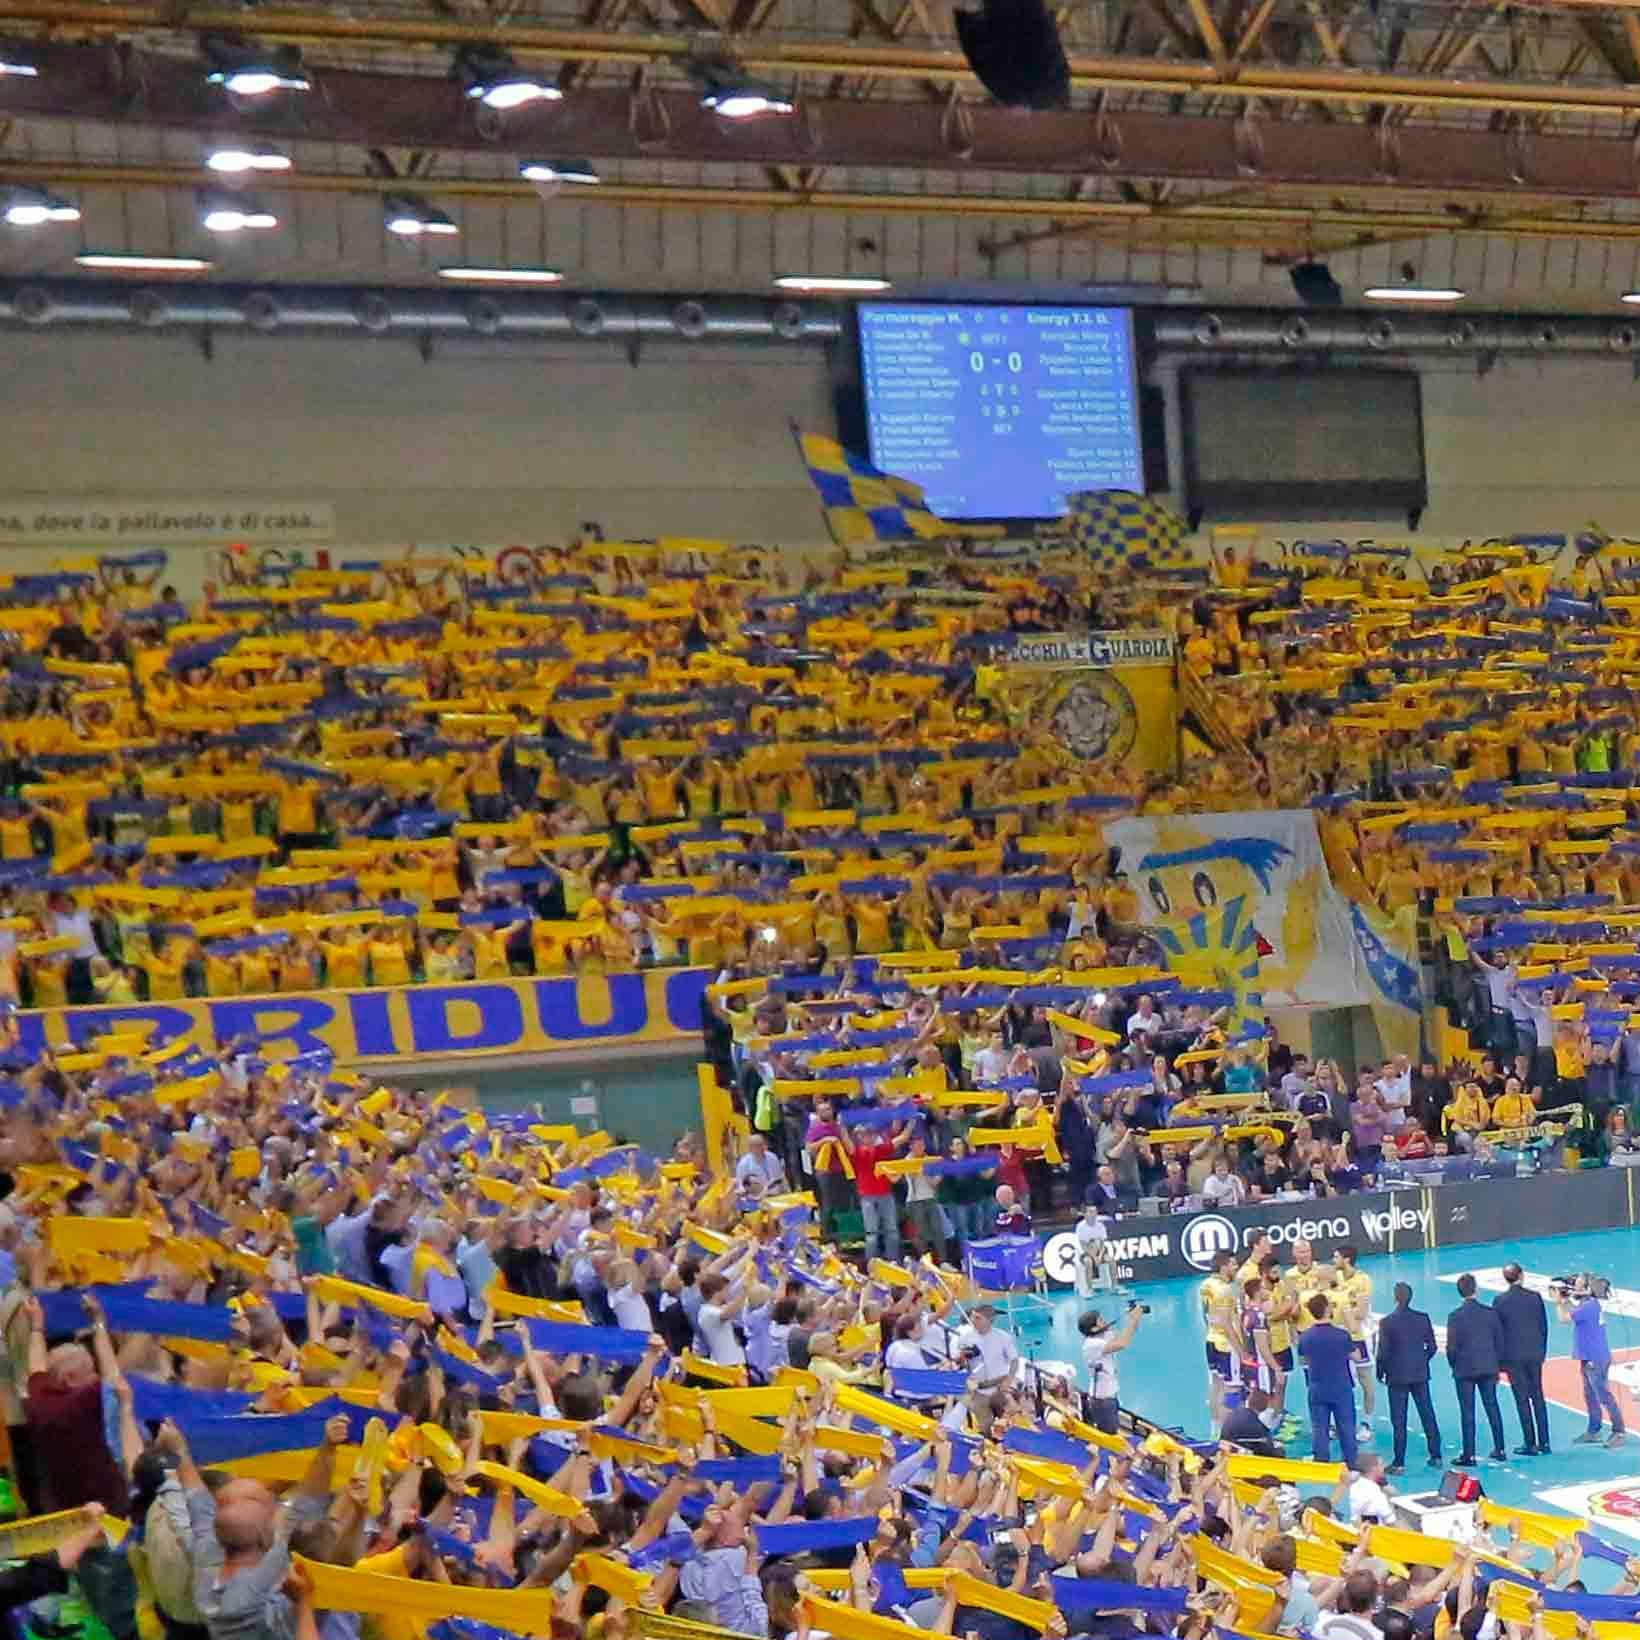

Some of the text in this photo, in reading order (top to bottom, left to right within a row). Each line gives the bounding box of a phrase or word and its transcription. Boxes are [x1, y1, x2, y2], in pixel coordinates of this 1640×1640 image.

[970, 351, 984, 373] 0
[1007, 351, 1021, 373] 0
[33, 511, 83, 529] dove
[90, 510, 111, 529] la
[1010, 634, 1171, 666] ECCHIA GUARDIA
